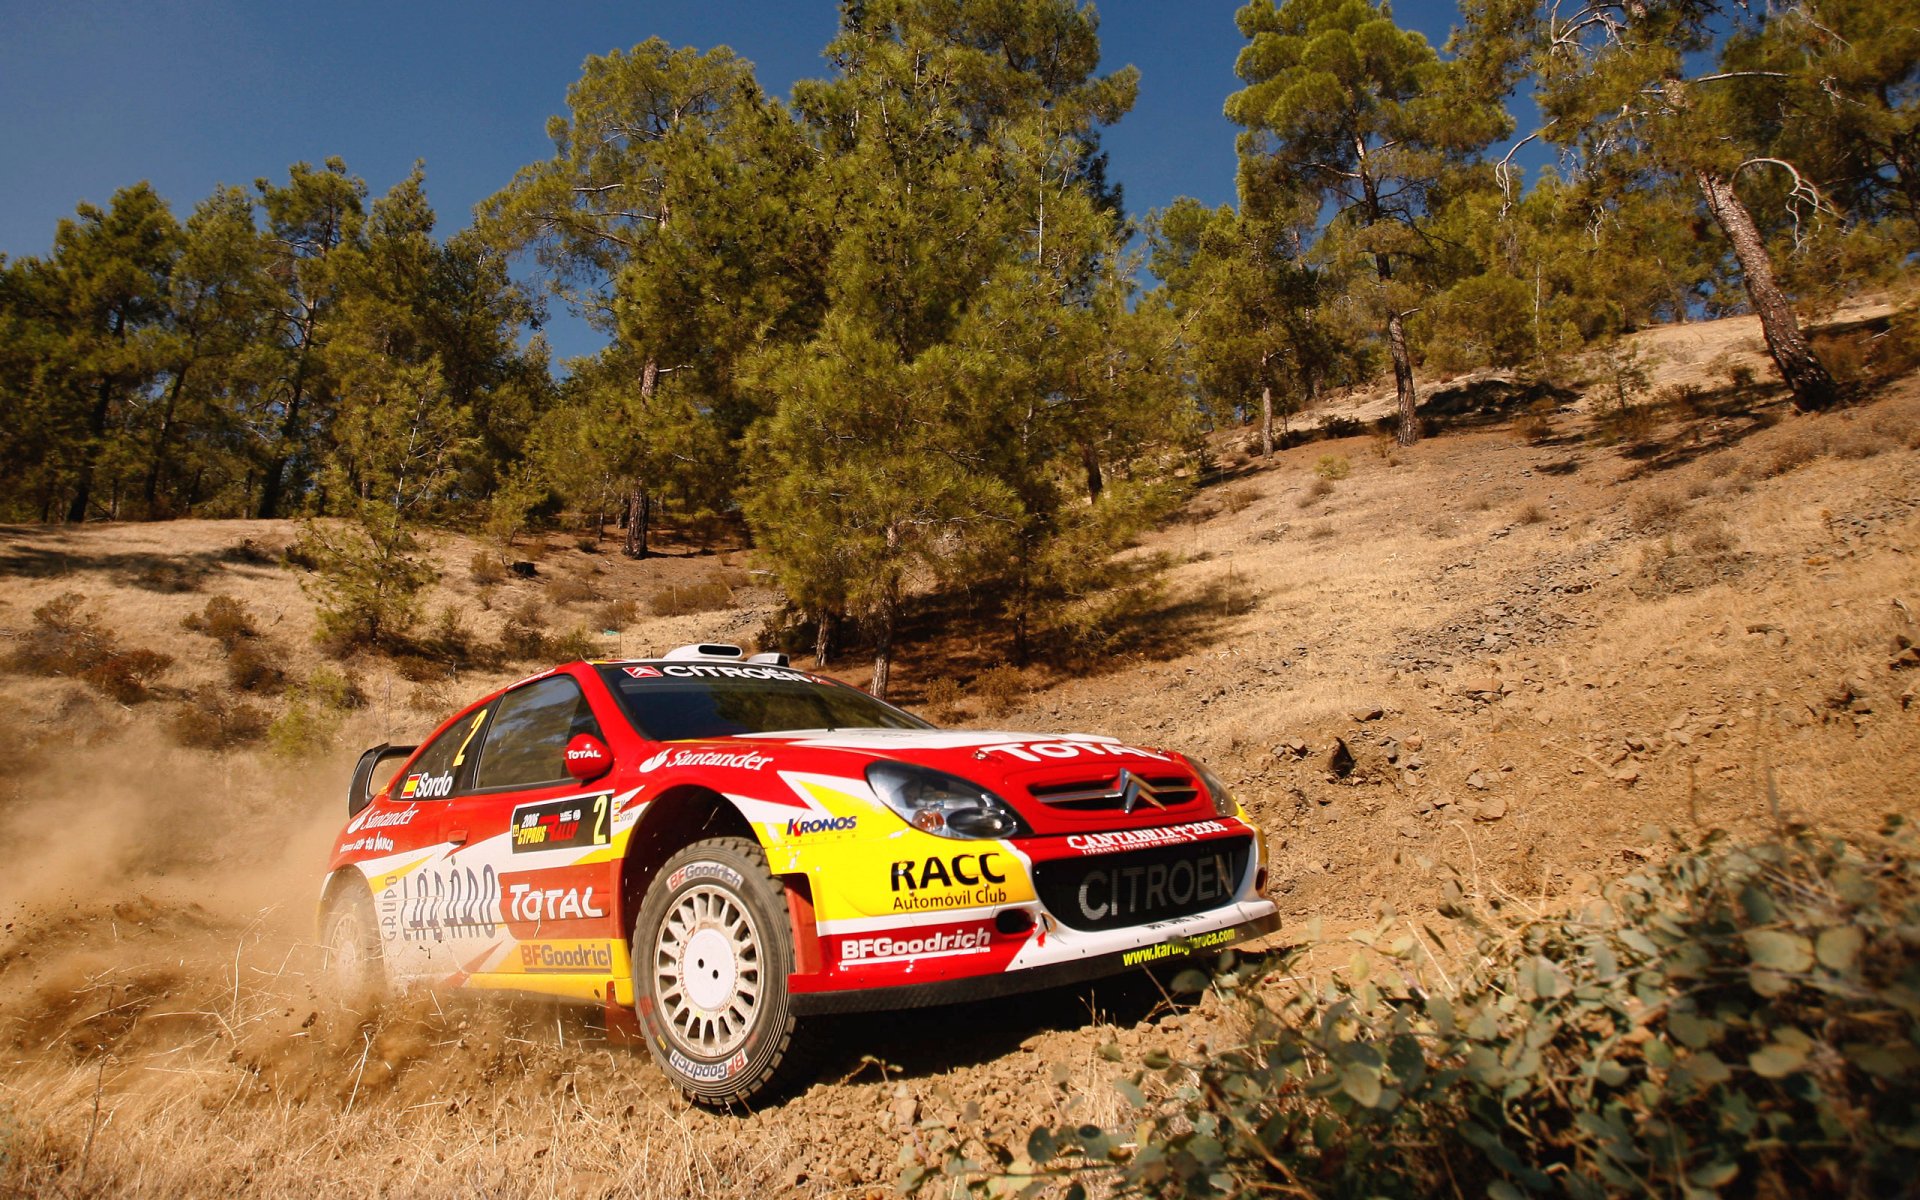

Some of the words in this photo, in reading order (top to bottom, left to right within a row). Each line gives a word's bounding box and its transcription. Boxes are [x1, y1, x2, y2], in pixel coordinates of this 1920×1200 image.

[663, 664, 812, 683] CITROËN
[452, 708, 488, 767] 2
[567, 748, 602, 760] TOTAL
[666, 749, 773, 771] Santander
[979, 741, 1172, 762] TOTAL
[416, 770, 454, 798] Sordo
[360, 802, 420, 831] Santander
[521, 813, 540, 828] 2006
[539, 814, 580, 842] RALLY
[593, 794, 608, 845] 2
[786, 813, 857, 837] KRONOS
[518, 825, 547, 845] CYPRUS
[1066, 828, 1177, 850] CANTABRIA
[670, 864, 741, 890] BFGoodrich
[891, 853, 1006, 892] RACC
[381, 875, 398, 941] GRUPO
[509, 883, 604, 921] TOTAL
[893, 889, 971, 911] Automóvil
[975, 888, 1007, 904] Club
[841, 928, 991, 960] BFGoodrich
[671, 1051, 745, 1080] BFGoodrich
